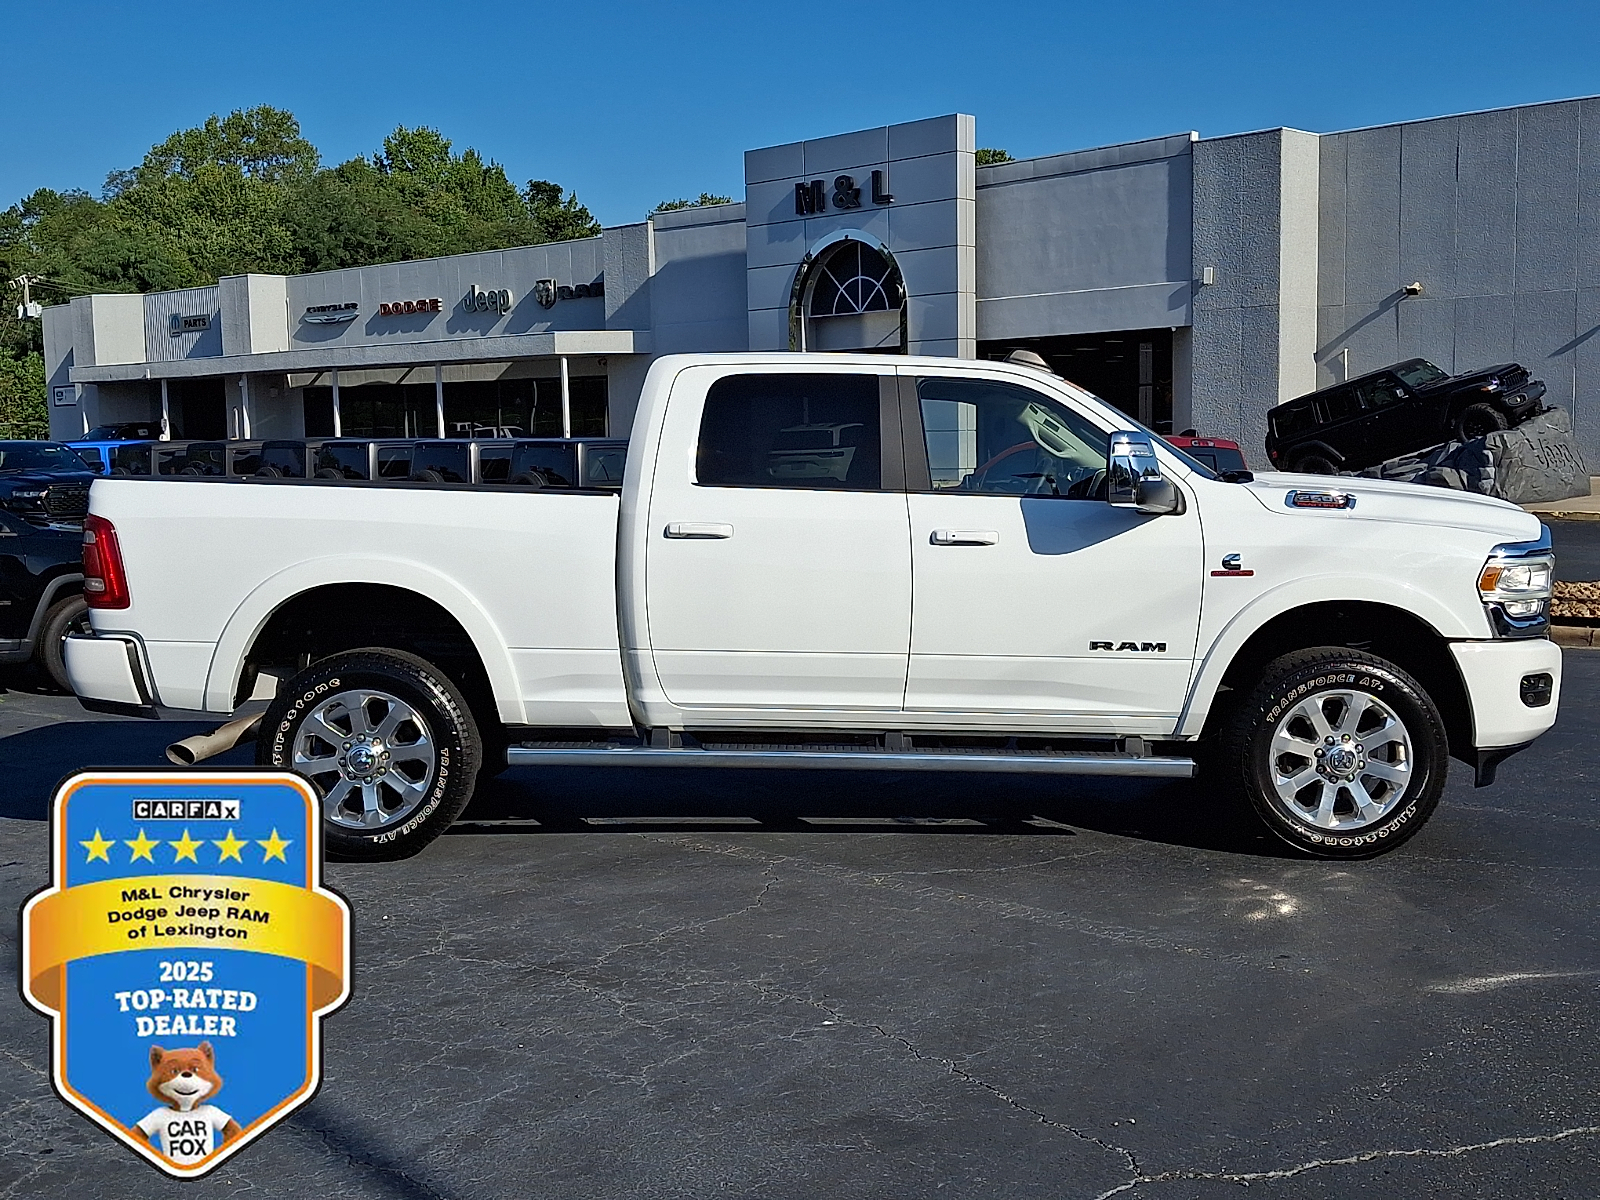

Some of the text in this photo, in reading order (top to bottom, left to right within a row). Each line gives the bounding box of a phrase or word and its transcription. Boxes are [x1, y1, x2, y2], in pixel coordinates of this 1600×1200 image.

[795, 169, 895, 215] M & L
[306, 302, 359, 314] CHRYSLER
[380, 297, 442, 316] DODGE
[463, 284, 513, 316] Jeep
[183, 317, 207, 329] PARTS
[1089, 641, 1167, 652] RAM
[1266, 674, 1356, 723] TRANSFORCE
[402, 748, 450, 836] TRANSFORCE
